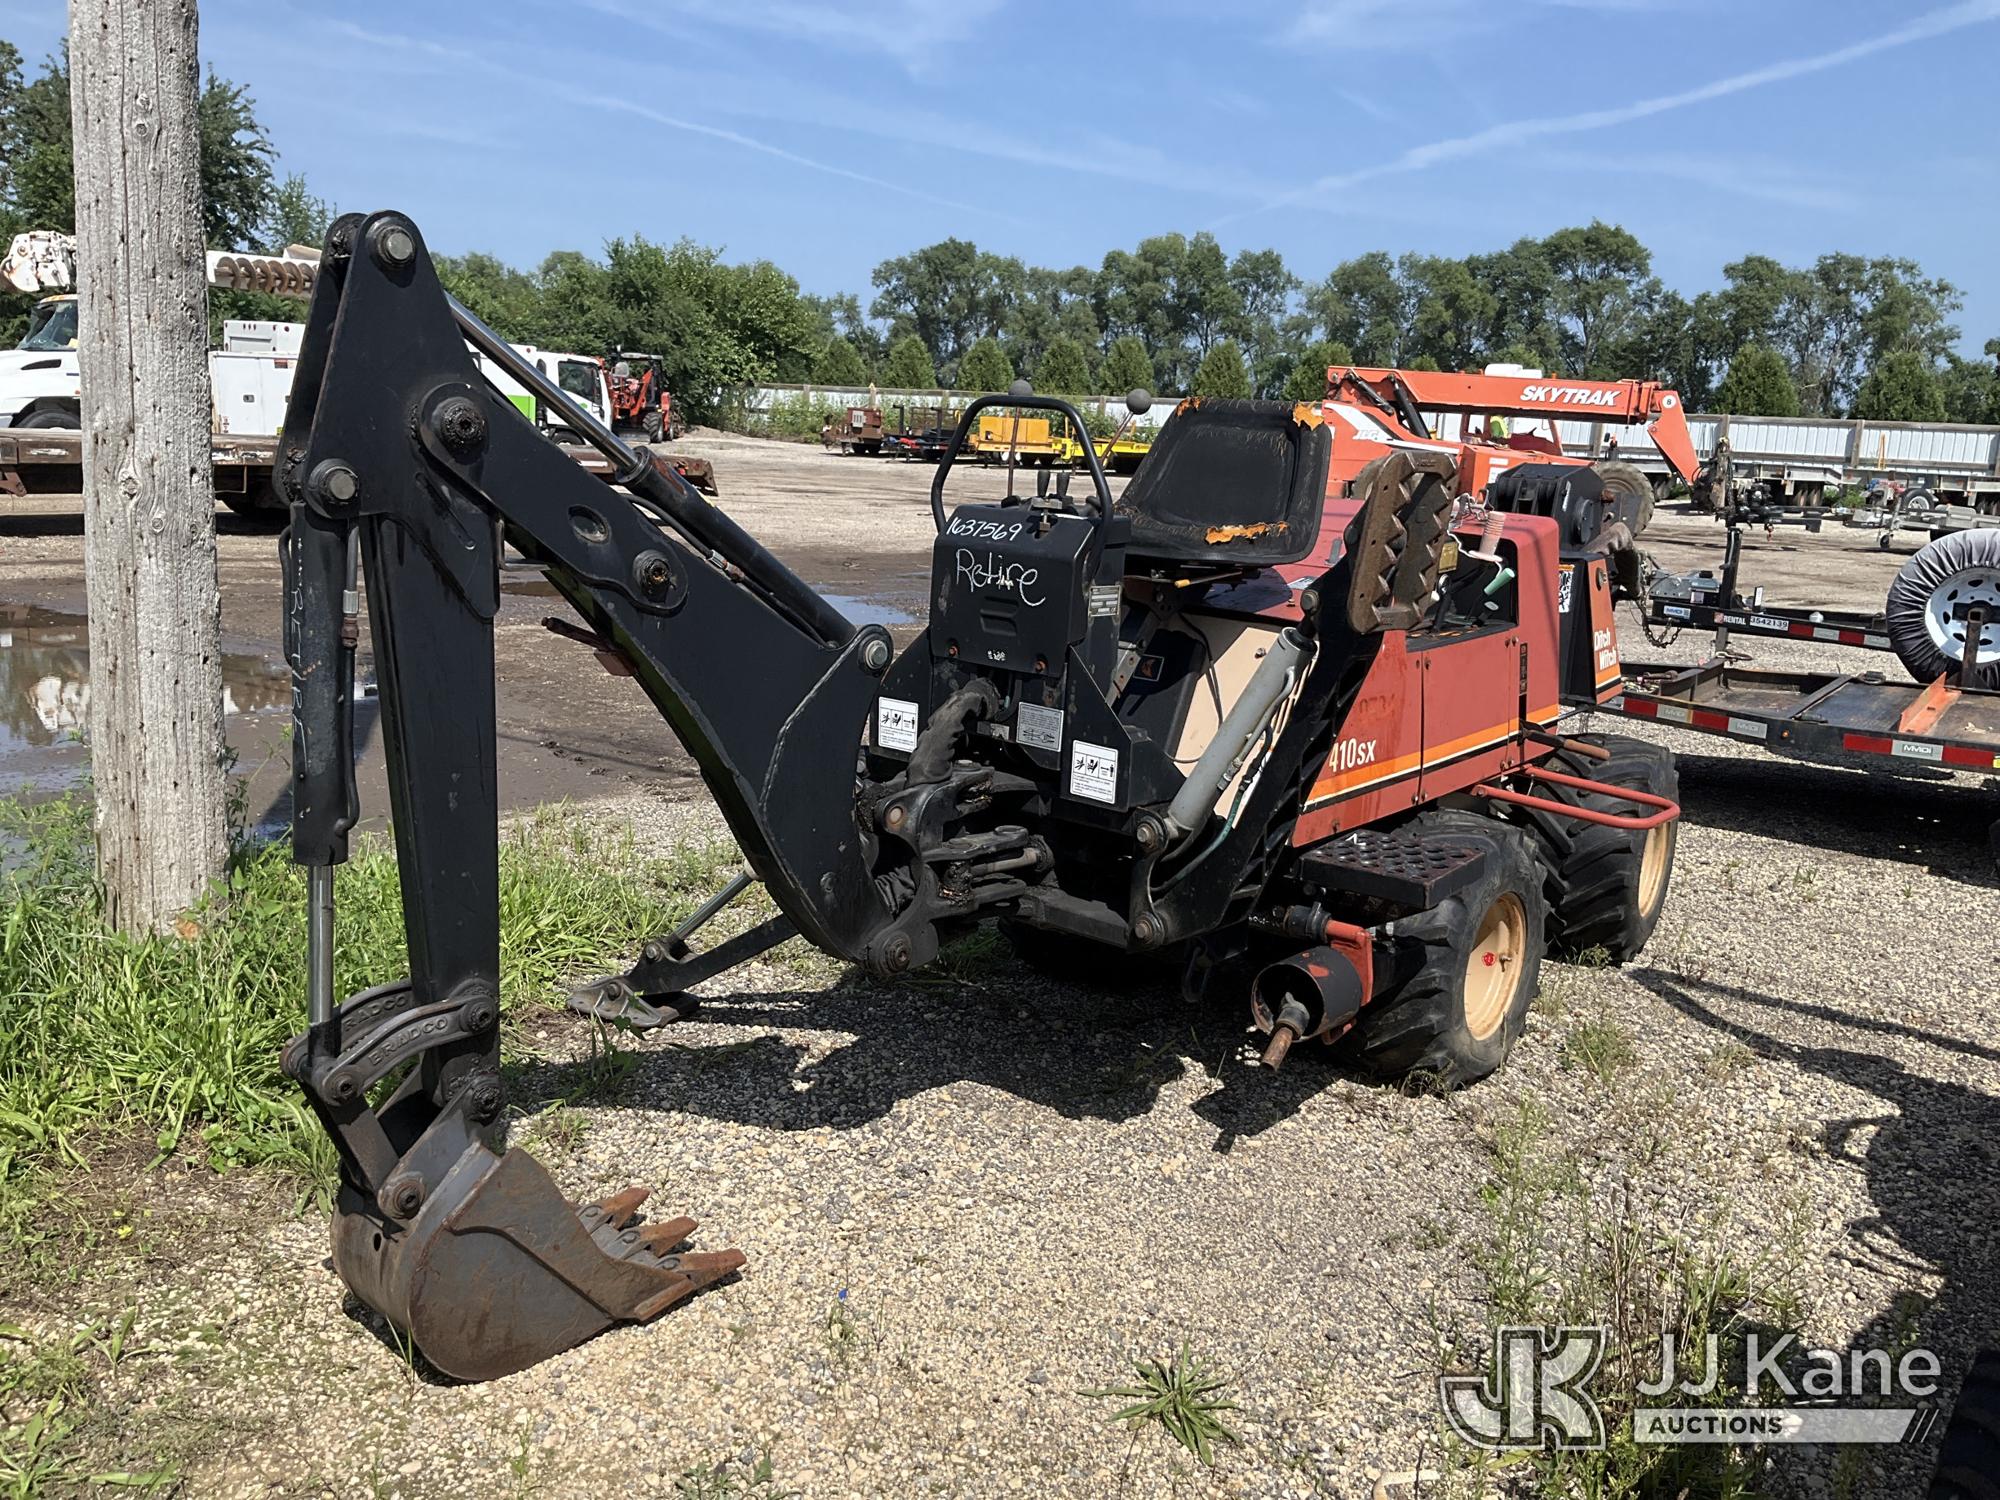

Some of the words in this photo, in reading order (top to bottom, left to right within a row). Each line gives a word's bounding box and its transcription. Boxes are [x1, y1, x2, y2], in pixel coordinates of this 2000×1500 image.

[1520, 386, 1621, 406] SKYTRAK
[946, 516, 1023, 542] 1637569
[955, 548, 1046, 607] Retire
[1723, 615, 1747, 626] RENTAL
[1750, 616, 1788, 629] 3542139
[1594, 627, 1611, 651] Ditch
[1599, 645, 1617, 670] Witch
[368, 1016, 449, 1066] BRADCO
